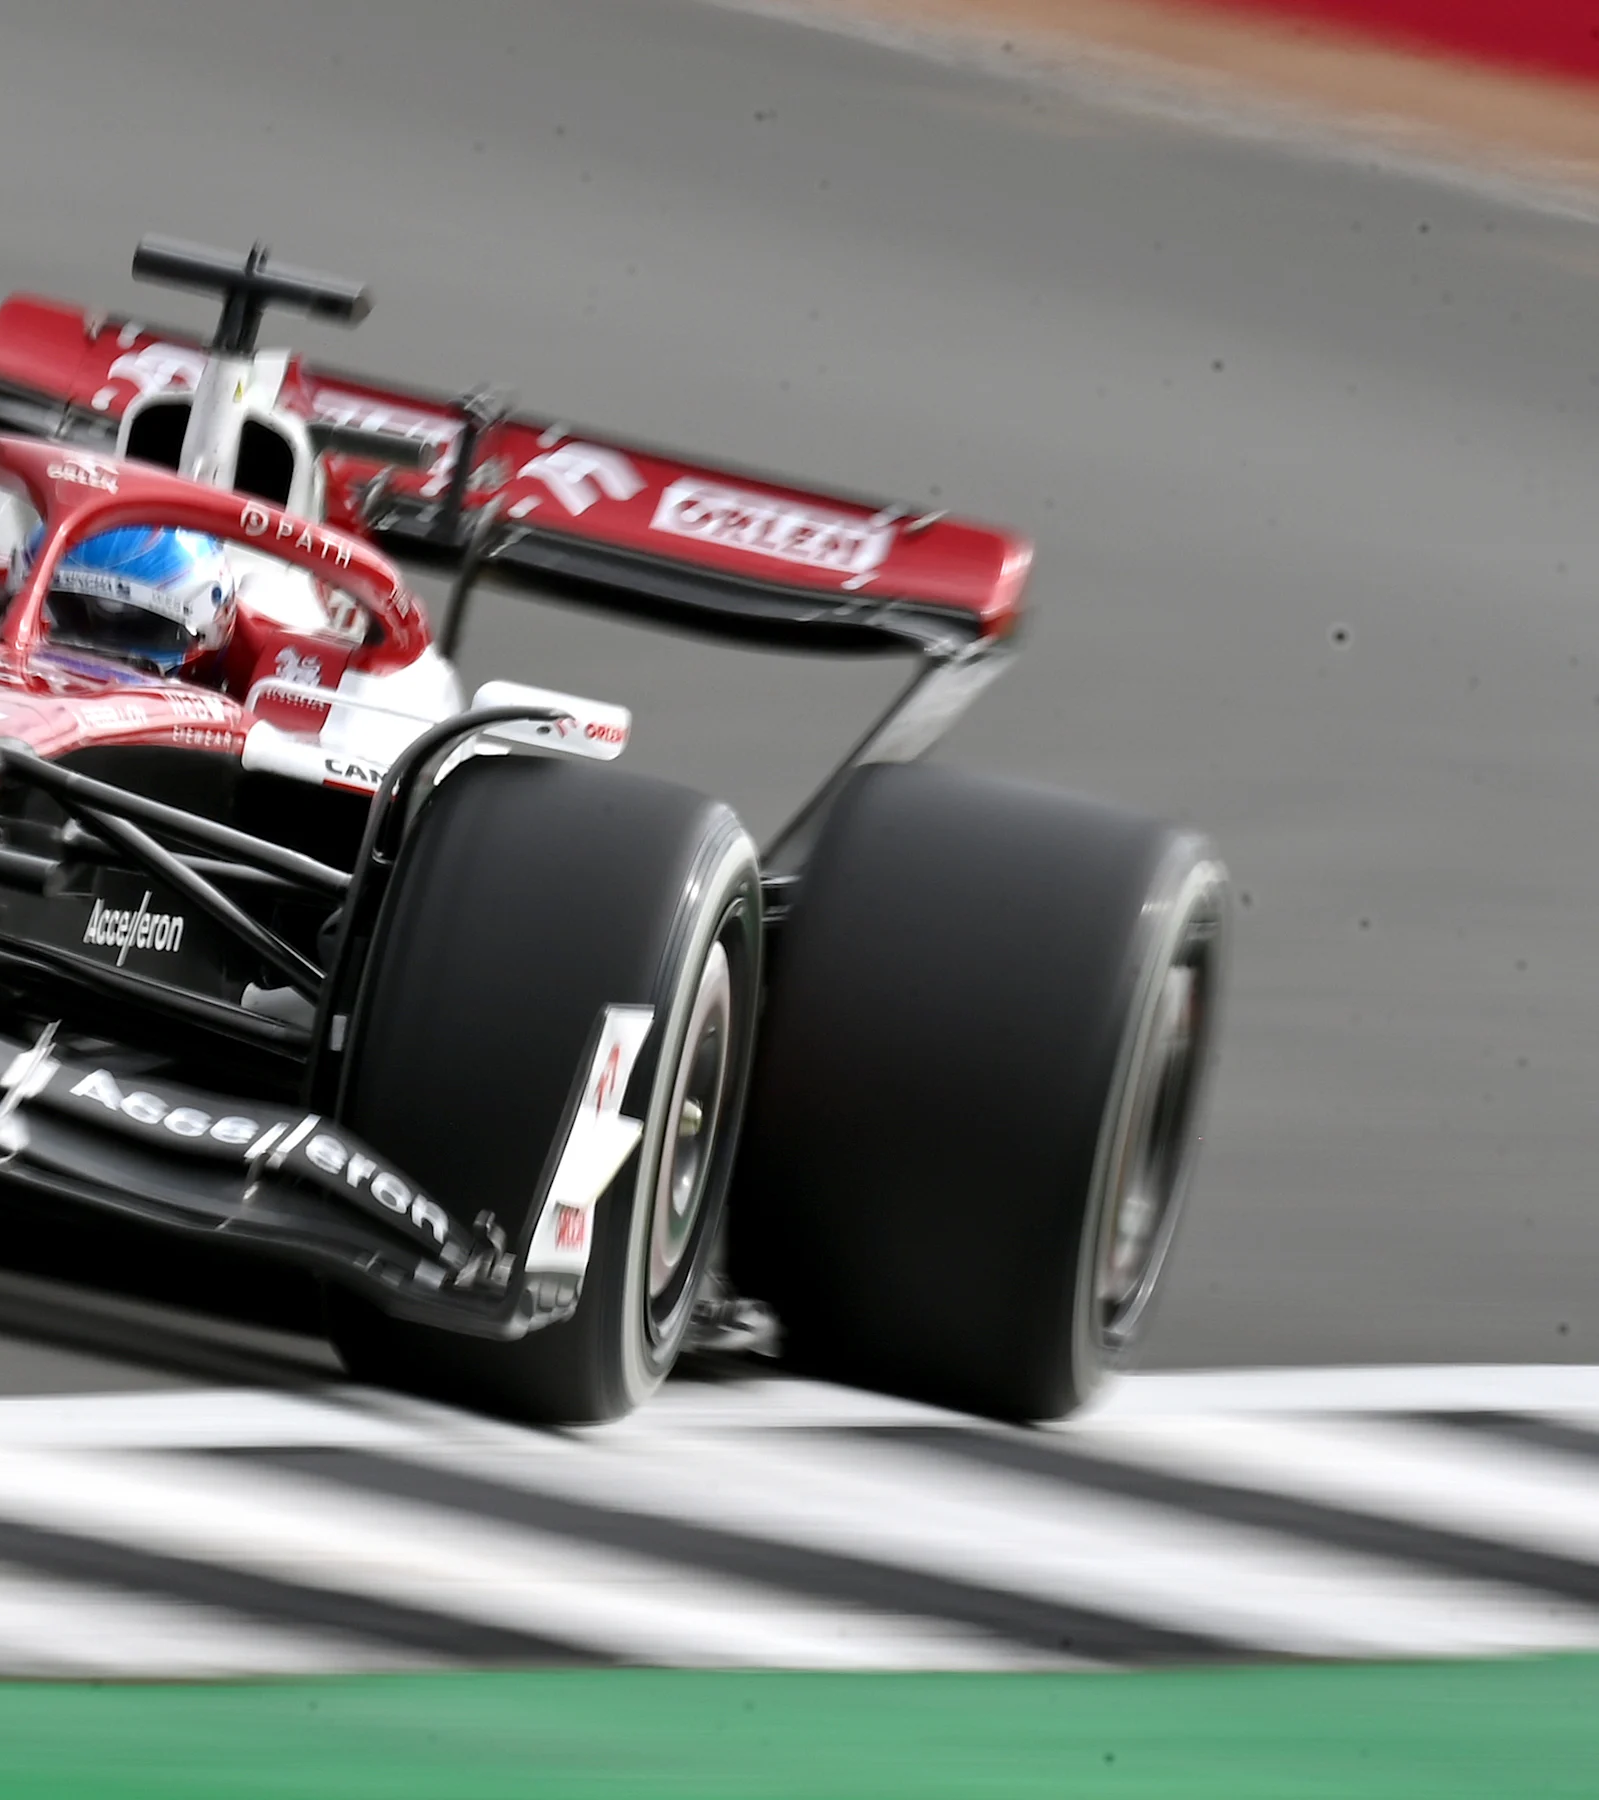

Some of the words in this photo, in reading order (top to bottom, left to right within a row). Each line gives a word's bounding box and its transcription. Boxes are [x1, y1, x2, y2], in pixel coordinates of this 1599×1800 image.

[275, 517, 353, 569] PATH
[671, 489, 869, 567] ORLEN
[82, 890, 185, 967] Accelleron
[69, 1068, 451, 1244] Accelleron
